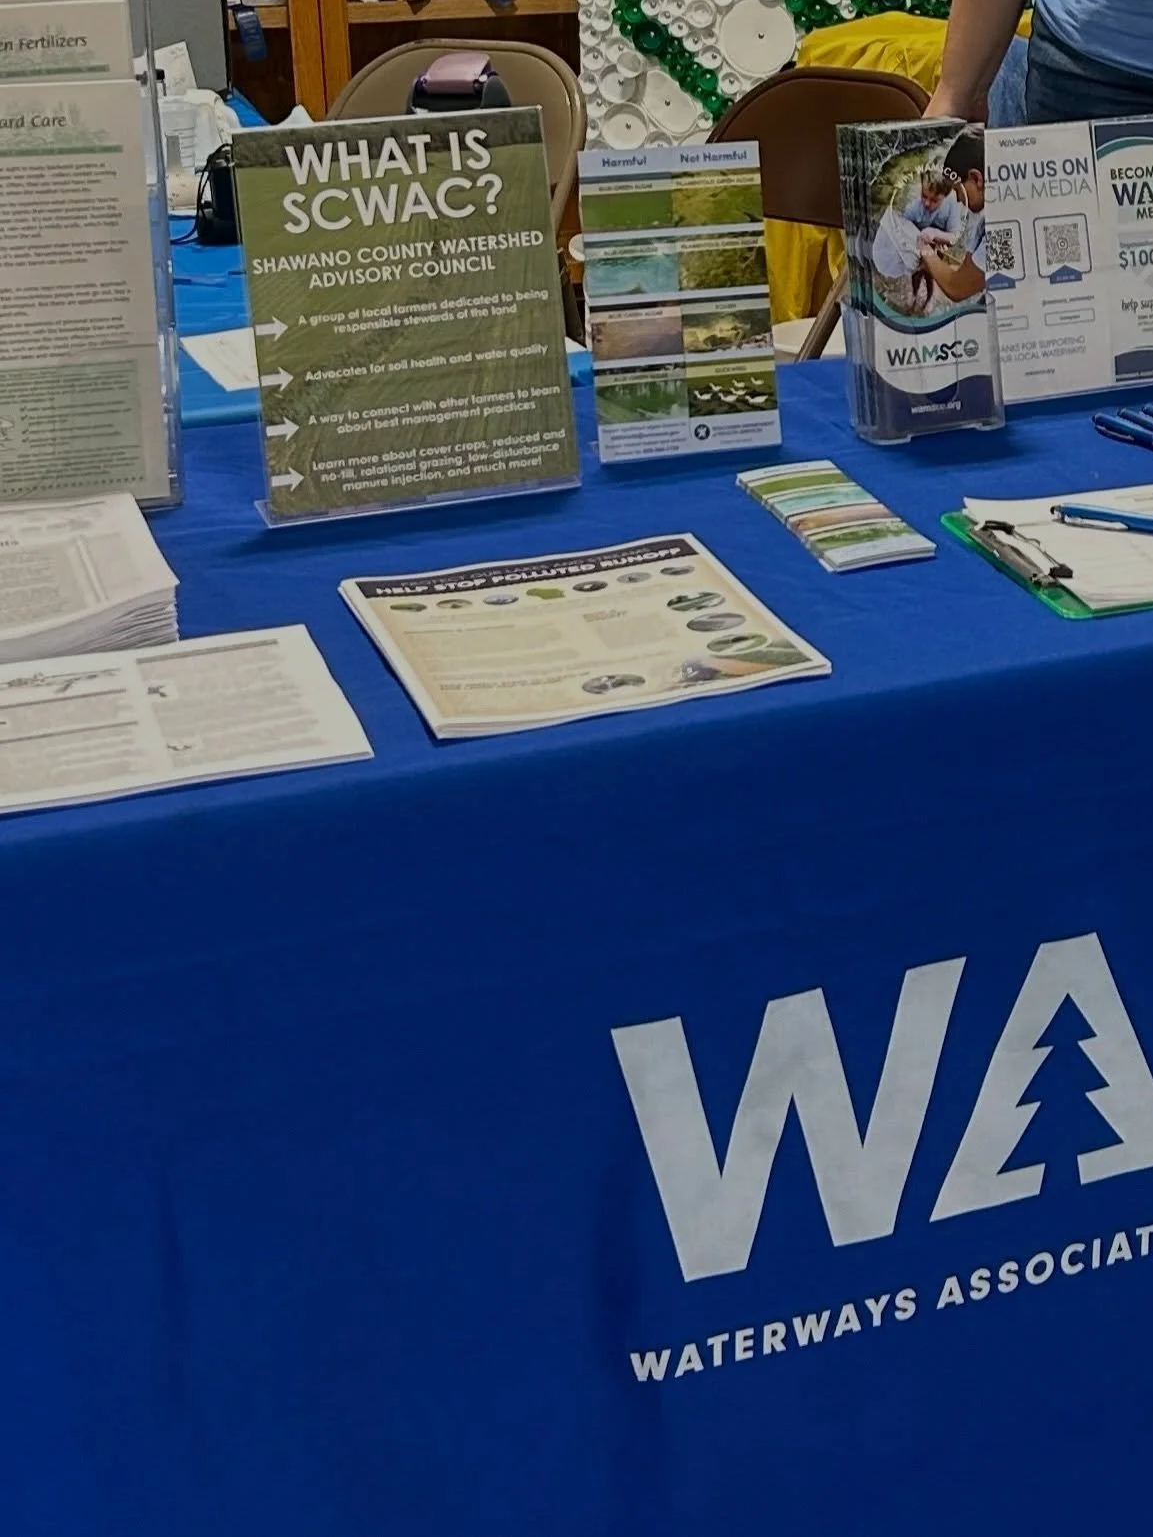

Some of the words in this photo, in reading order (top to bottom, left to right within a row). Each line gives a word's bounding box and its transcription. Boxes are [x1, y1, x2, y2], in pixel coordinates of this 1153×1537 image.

[19, 34, 88, 50] Fertilizers
[31, 114, 66, 128] Care
[284, 133, 431, 186] WHAT
[449, 128, 492, 172] IS
[602, 154, 647, 168] Harmful
[680, 153, 700, 164] Not
[703, 150, 748, 163] Harmful
[1033, 160, 1057, 178] US
[1062, 157, 1088, 176] ON
[283, 173, 503, 234] SCWAC?
[1031, 177, 1093, 199] MEDIA
[252, 249, 351, 276] SHAWANO
[357, 240, 435, 264] COUNTY
[440, 230, 544, 256] WATERSHED
[308, 263, 402, 290] ADVISORY
[408, 254, 496, 279] COUNCIL
[298, 314, 308, 326] A
[310, 311, 345, 327] group
[348, 309, 361, 320] of
[361, 306, 392, 319] local
[393, 301, 438, 315] farmers
[440, 293, 499, 311] dedicated
[501, 292, 513, 303] to
[515, 288, 549, 302] being
[333, 317, 401, 335] responsible
[403, 311, 455, 327] stewards
[456, 309, 469, 321] of
[470, 306, 490, 318] the
[491, 303, 518, 316] land
[1121, 298, 1138, 313] help
[304, 366, 367, 382] Advocates
[369, 362, 385, 374] for
[388, 359, 409, 371] soil
[410, 355, 447, 370] health
[449, 352, 473, 364] and
[474, 348, 508, 361] water
[509, 342, 549, 358] quality
[886, 339, 979, 367] WAMSCO
[308, 414, 318, 426] A
[320, 413, 345, 426] way
[347, 409, 360, 420] to
[362, 402, 410, 419] connect
[412, 399, 437, 412] with
[439, 395, 469, 410] other
[471, 391, 516, 405] farmers
[517, 387, 529, 399] to
[531, 383, 561, 397] learn
[336, 421, 372, 435] about
[374, 417, 400, 431] best
[402, 407, 481, 427] management
[483, 400, 536, 418] practices
[911, 400, 961, 414] wamsco.org
[312, 458, 346, 472] Learn
[347, 454, 379, 467] more
[382, 450, 417, 463] about
[419, 445, 452, 458] cover
[455, 440, 489, 456] crops,
[492, 431, 540, 448] reduced
[543, 428, 566, 441] and
[360, 461, 417, 476] rotational
[419, 455, 466, 472] grazing,
[468, 442, 560, 464] low-disturbance
[342, 477, 389, 492] manure
[391, 470, 445, 488] injection,
[447, 464, 471, 478] and
[473, 460, 507, 474] much
[508, 455, 543, 469] more!
[375, 585, 428, 594] HELP
[434, 578, 486, 591] STOP
[492, 563, 596, 584] POLLUTED
[601, 547, 681, 568] RUNOFF
[629, 1286, 919, 1383] WATERWAYS
